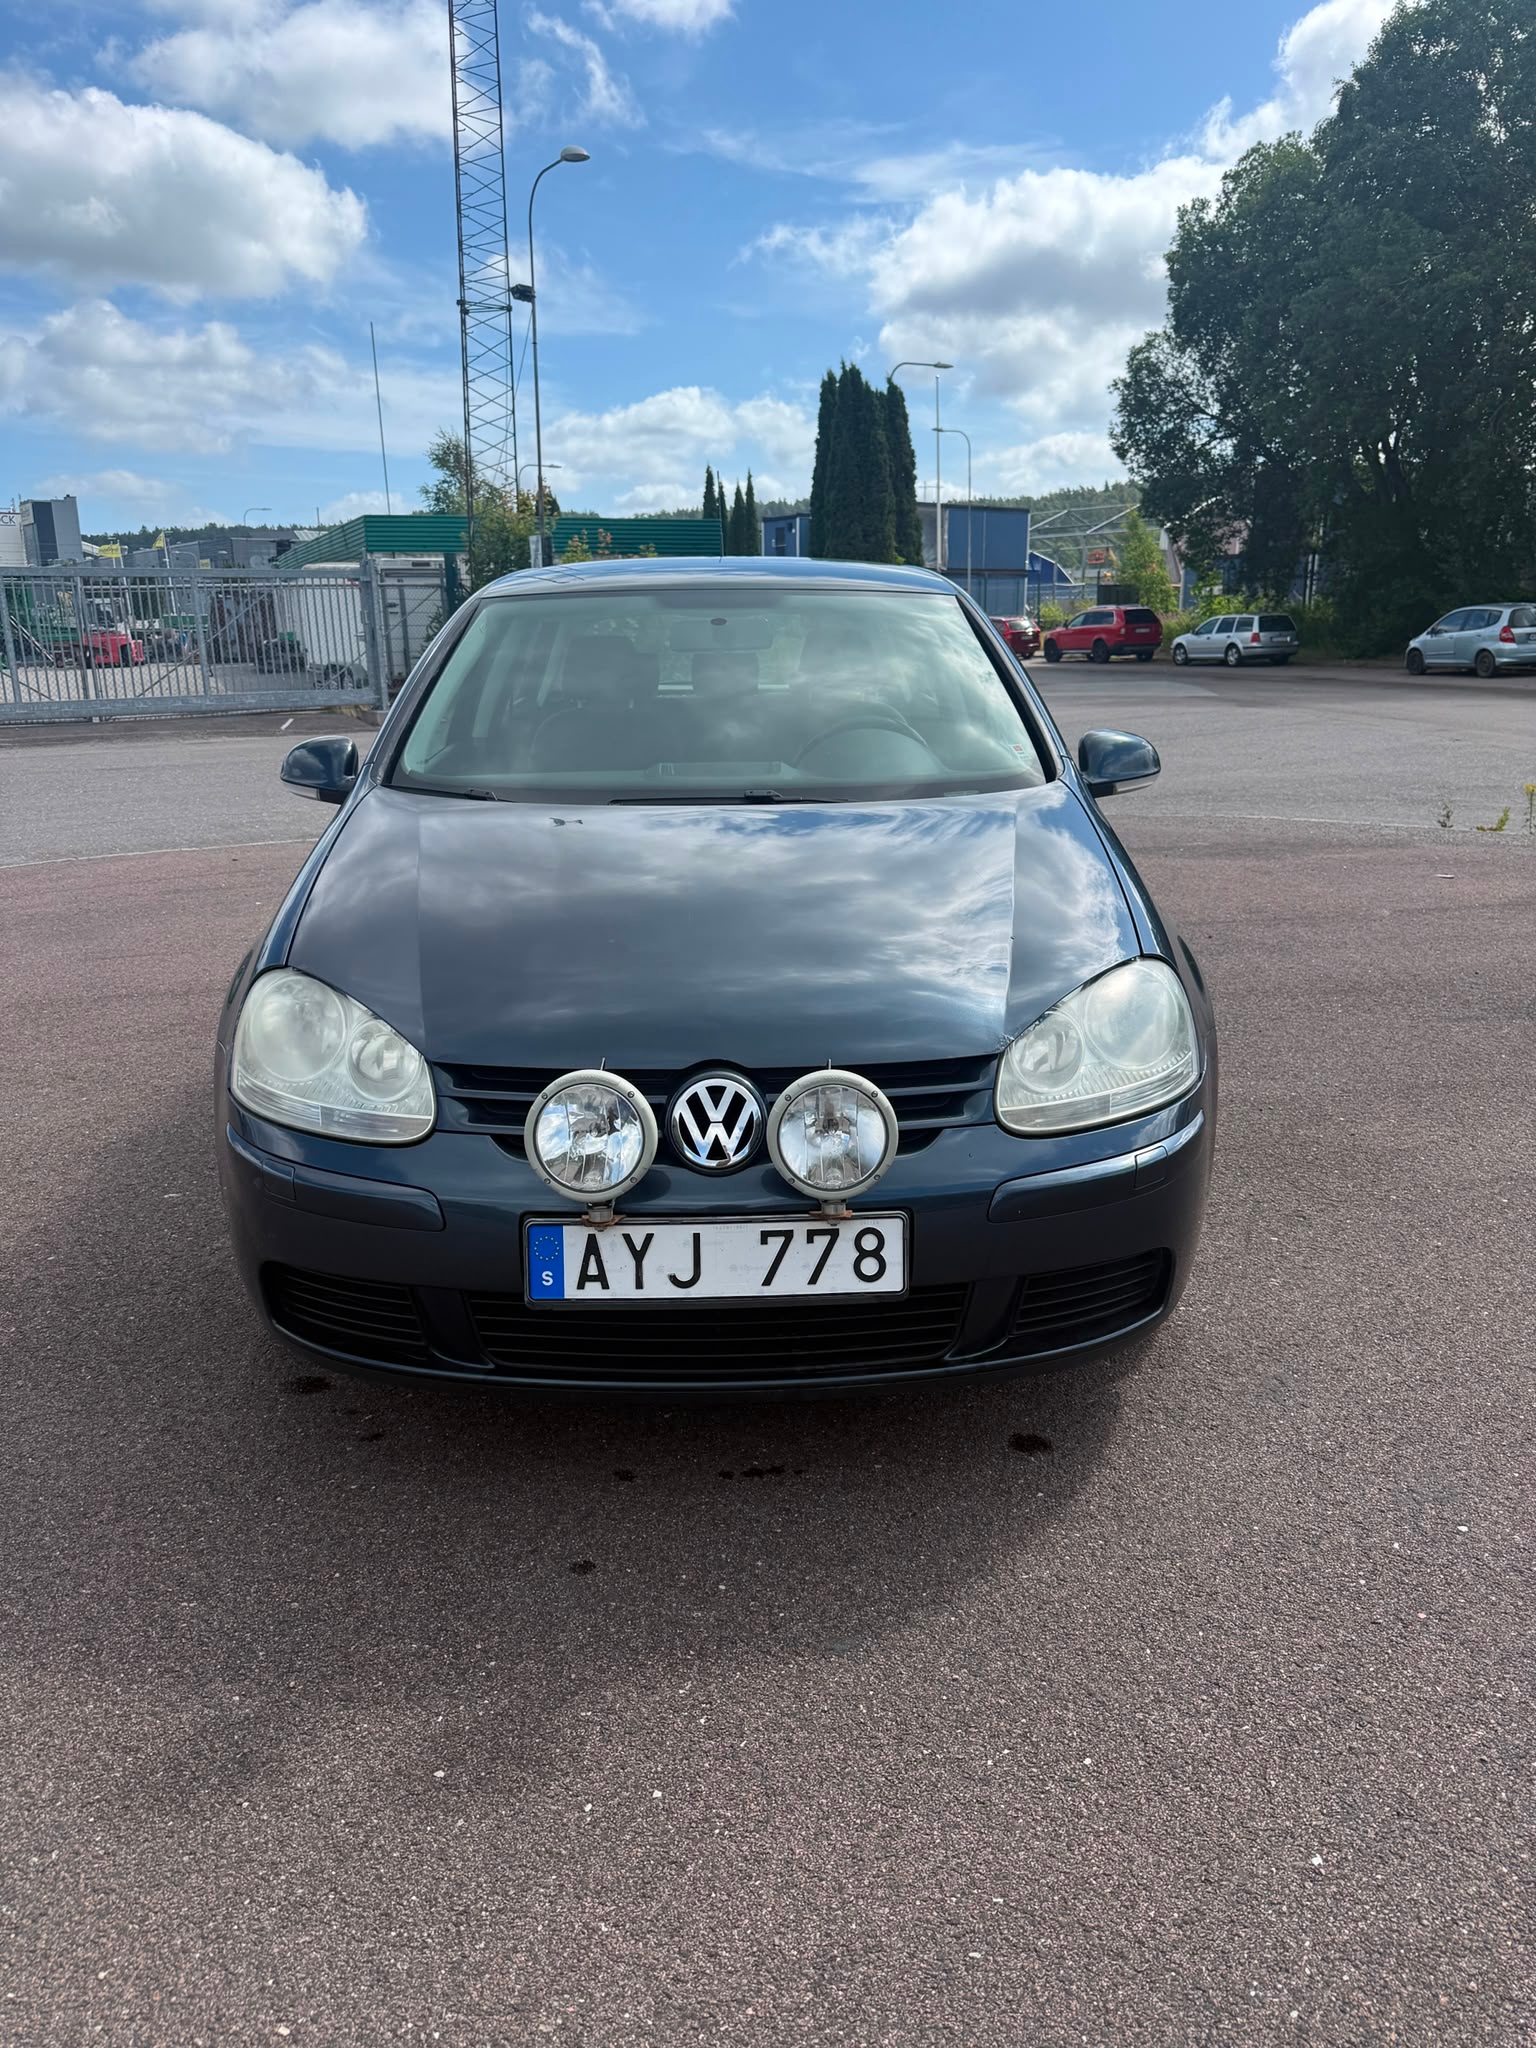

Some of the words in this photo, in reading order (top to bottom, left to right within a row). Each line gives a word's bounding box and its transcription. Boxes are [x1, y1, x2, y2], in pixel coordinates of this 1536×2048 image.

[673, 1079, 761, 1167] VW
[541, 1270, 554, 1286] S
[576, 1232, 702, 1290] AYJ
[760, 1226, 887, 1287] 778
